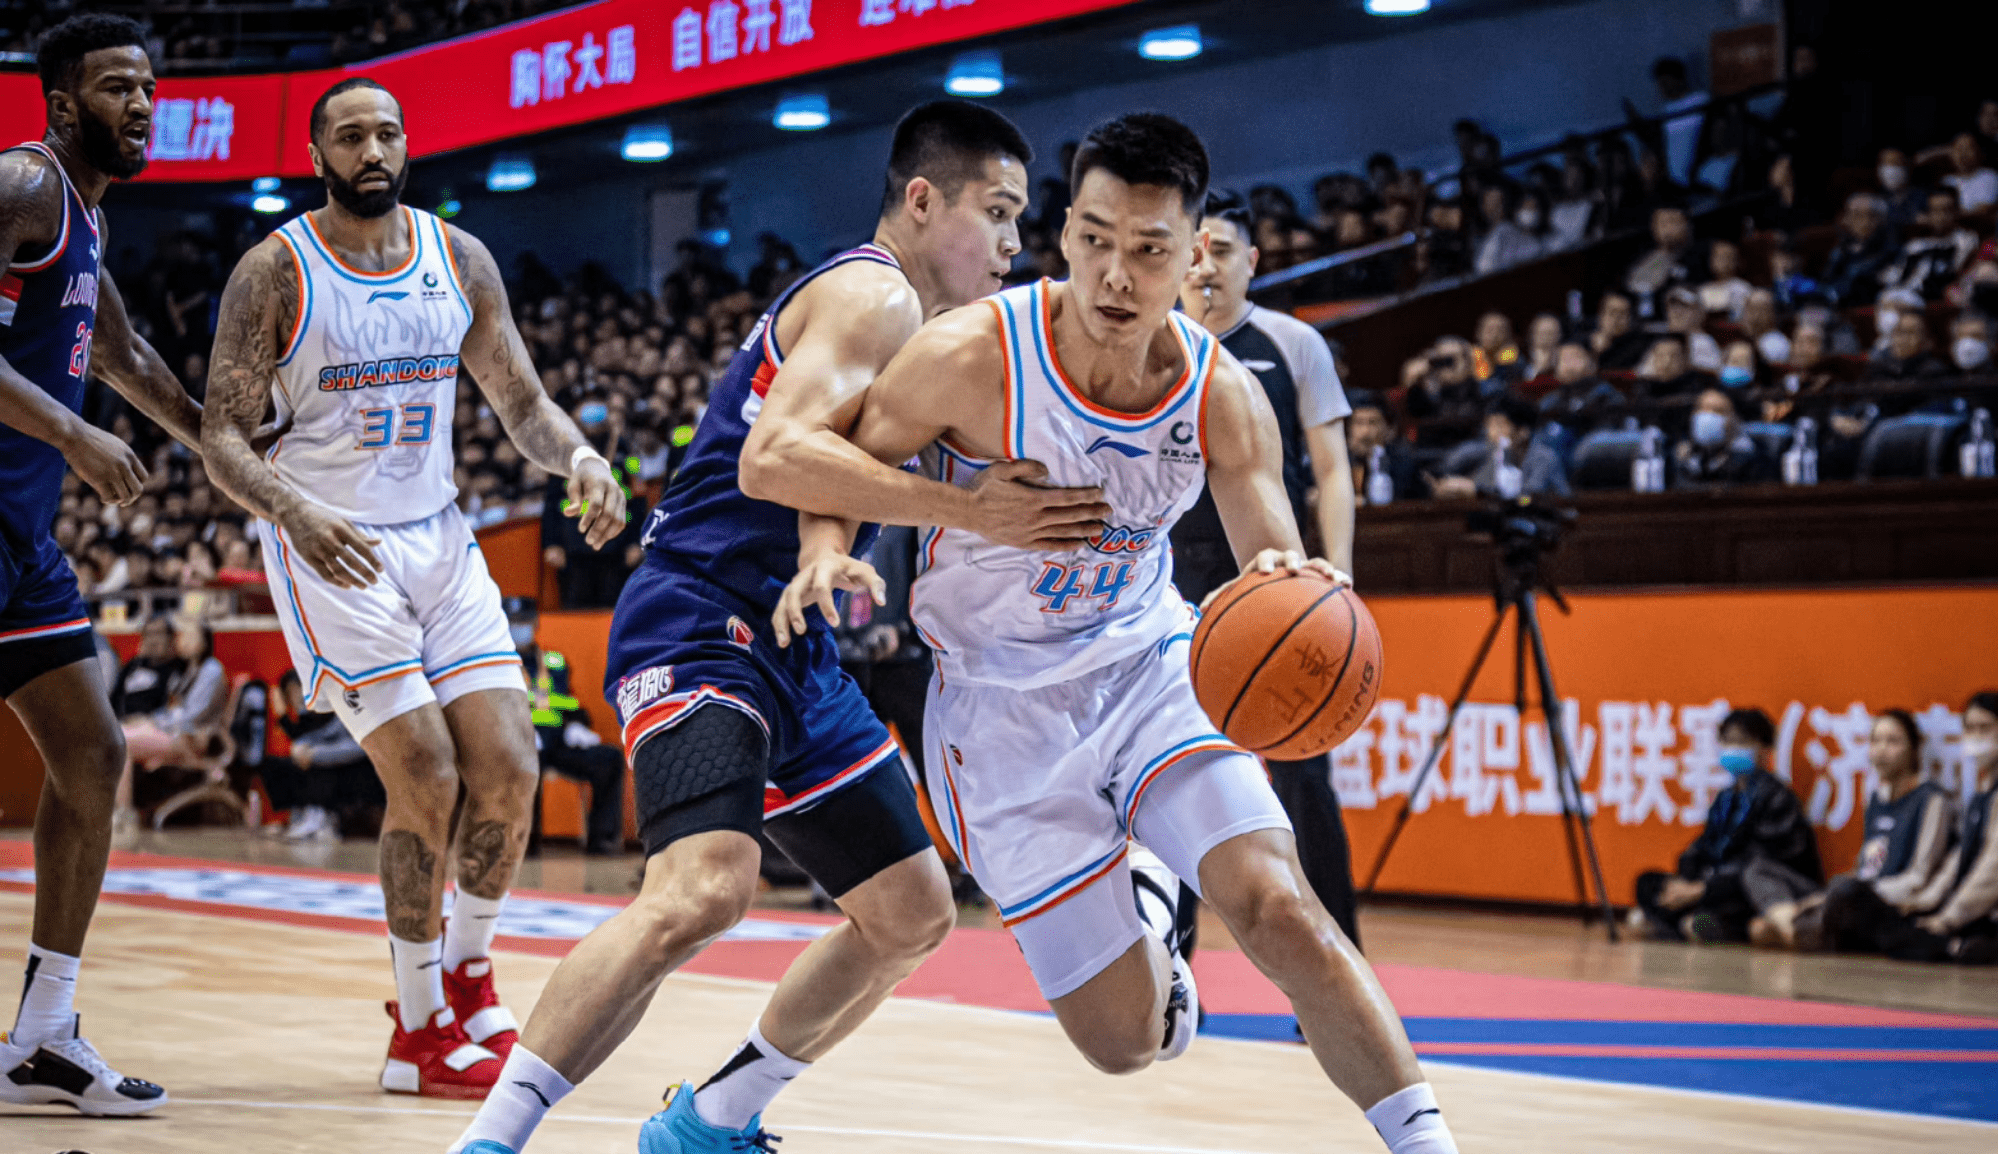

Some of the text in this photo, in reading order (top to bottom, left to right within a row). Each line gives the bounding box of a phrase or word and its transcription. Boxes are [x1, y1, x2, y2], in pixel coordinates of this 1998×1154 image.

[508, 0, 815, 109] 胸怀大局 自信开放
[354, 402, 437, 450] 33
[1030, 560, 1137, 613] 44
